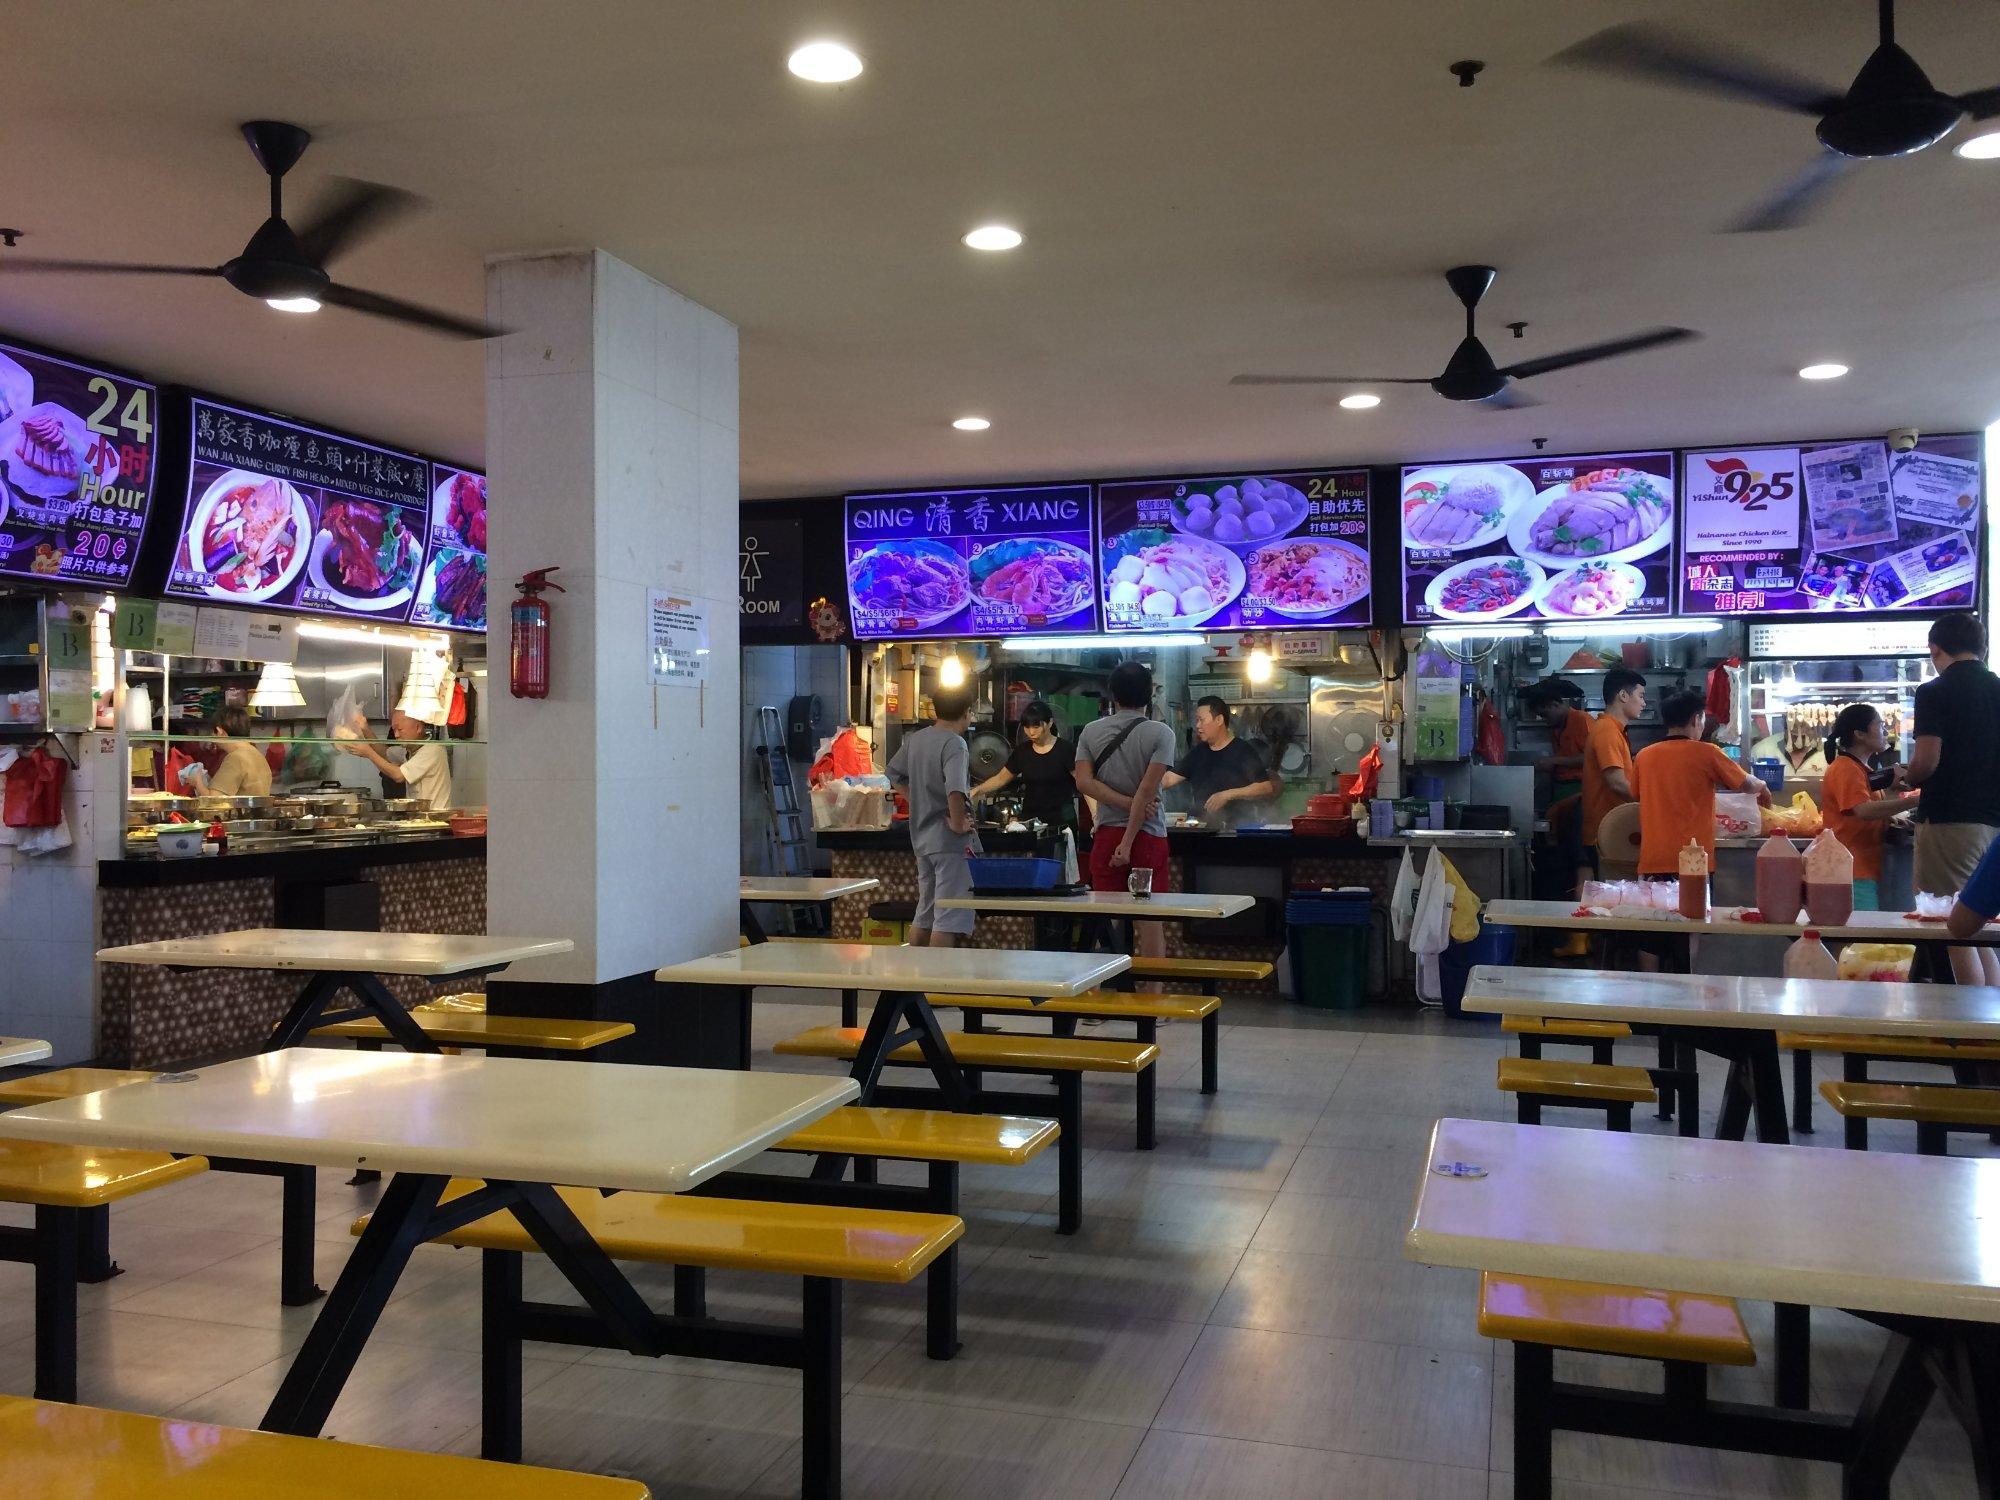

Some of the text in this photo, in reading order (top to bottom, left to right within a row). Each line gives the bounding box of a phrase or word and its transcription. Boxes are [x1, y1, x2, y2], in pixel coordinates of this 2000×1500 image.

[86, 377, 153, 443] 24
[84, 436, 150, 483] 小时
[198, 445, 219, 460] WAN
[220, 451, 234, 463] JIA
[235, 454, 264, 469] XIANG
[265, 461, 291, 475] CURRY
[292, 468, 308, 480] FISH
[359, 484, 373, 494] VEG
[80, 472, 145, 510] Hour
[1308, 477, 1338, 499] 24
[1342, 489, 1366, 498] Hour
[1723, 470, 1794, 511] 925
[73, 502, 143, 529] 打包盒子加
[854, 496, 1079, 535] QING 清 香 XIANG
[1309, 499, 1366, 515] 自助优先
[73, 520, 84, 528] Take
[86, 523, 101, 532] Away
[1309, 522, 1339, 533] 打包加
[74, 530, 128, 560] 20¢
[60, 555, 129, 577] 照片只供参考
[1700, 553, 1766, 563] RECOMMENDED
[169, 584, 182, 593] Curry
[128, 613, 144, 636] B
[62, 632, 79, 658] B
[1429, 728, 1445, 749] B
